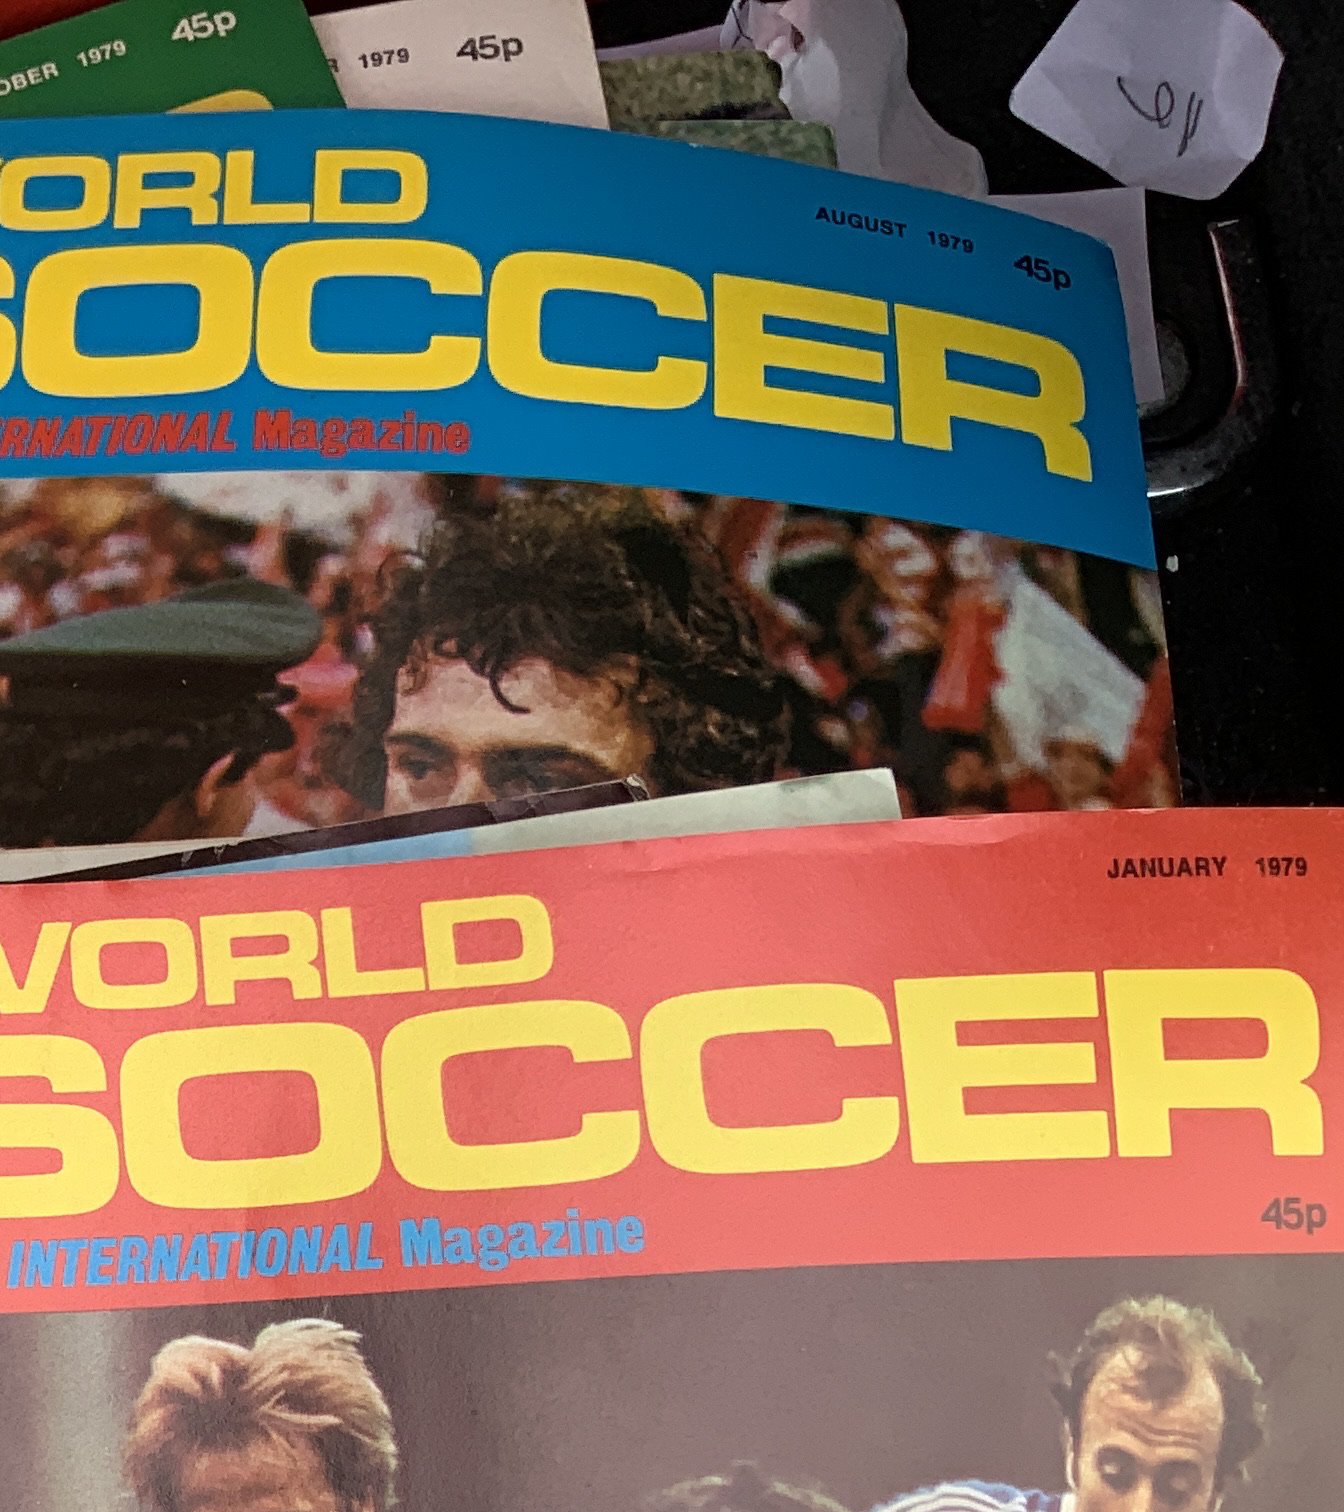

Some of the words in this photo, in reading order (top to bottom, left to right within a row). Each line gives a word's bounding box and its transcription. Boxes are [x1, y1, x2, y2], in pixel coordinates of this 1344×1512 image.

[76, 39, 127, 67] 1979
[171, 10, 237, 42] 45p
[358, 47, 410, 69] 1979
[456, 35, 524, 62] 45p
[815, 206, 907, 238] AUGUST
[927, 230, 974, 253] 1979
[1014, 254, 1072, 290] 45p
[253, 410, 471, 459] Magazine
[1107, 855, 1227, 879] JANUARY
[1255, 855, 1308, 878] 1979
[1260, 1197, 1327, 1235] 45p
[8, 1221, 384, 1289] INTERNATIONAL
[400, 1207, 646, 1272] Magazine
